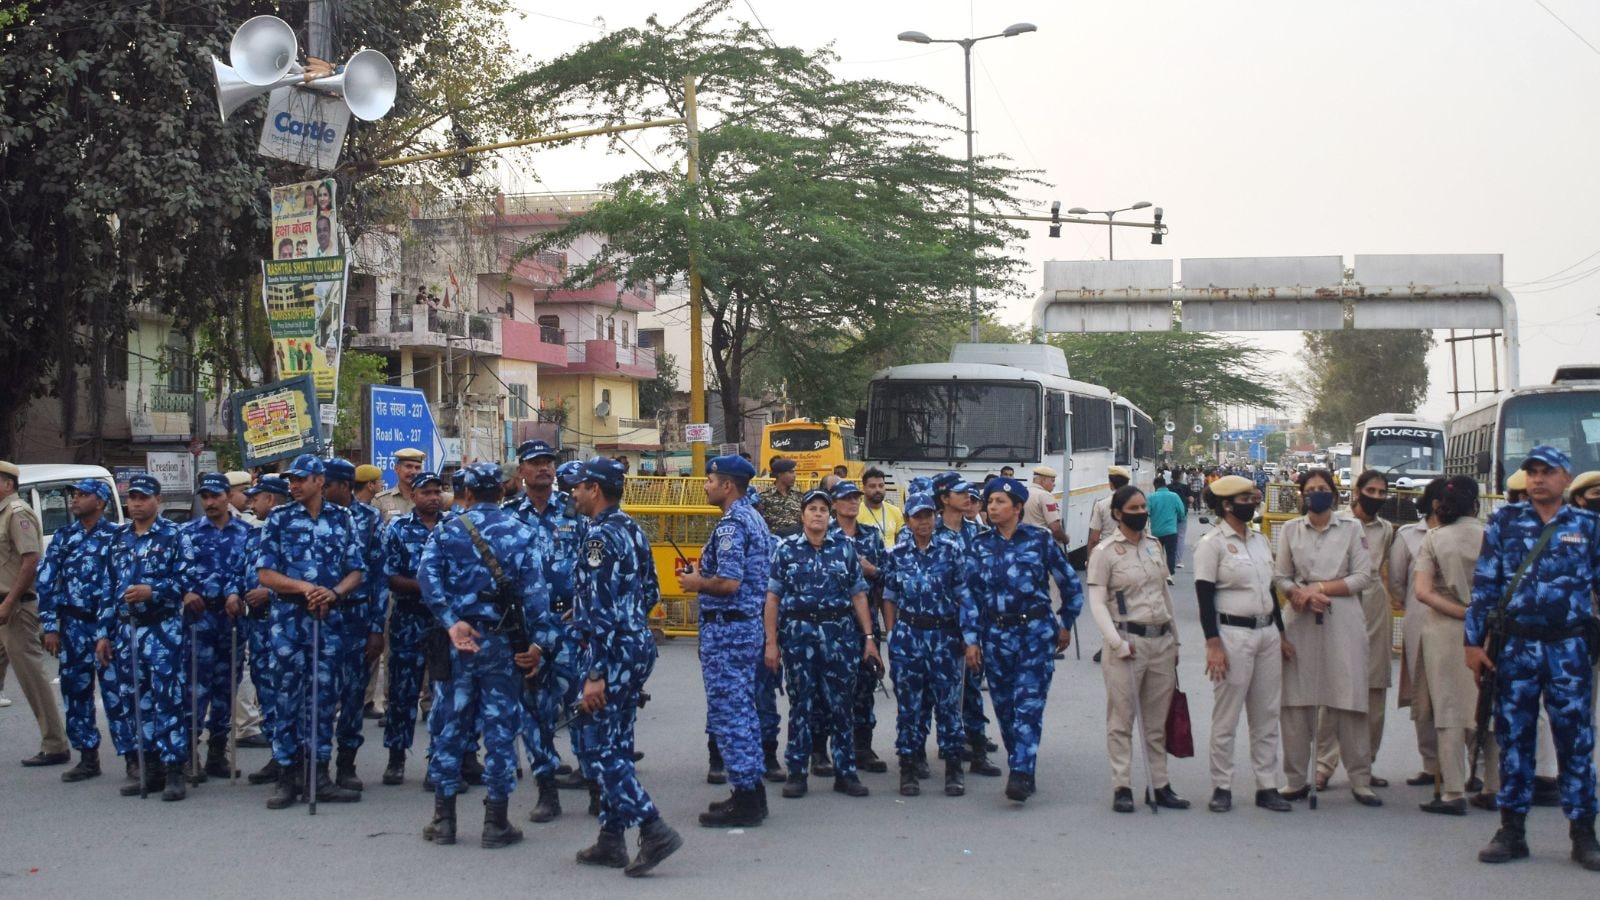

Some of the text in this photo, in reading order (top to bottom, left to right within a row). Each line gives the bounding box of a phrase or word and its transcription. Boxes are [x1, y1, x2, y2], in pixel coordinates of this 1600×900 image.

[275, 112, 336, 143] Castle
[267, 258, 343, 276] RASHTRA SHAKTI VIDYALAYA
[376, 397, 387, 415] रोड
[390, 397, 406, 416] संख्या
[376, 428, 392, 440] Road
[394, 428, 405, 442] No.
[1370, 428, 1440, 439] TOURIST
[151, 459, 179, 473] Creation
